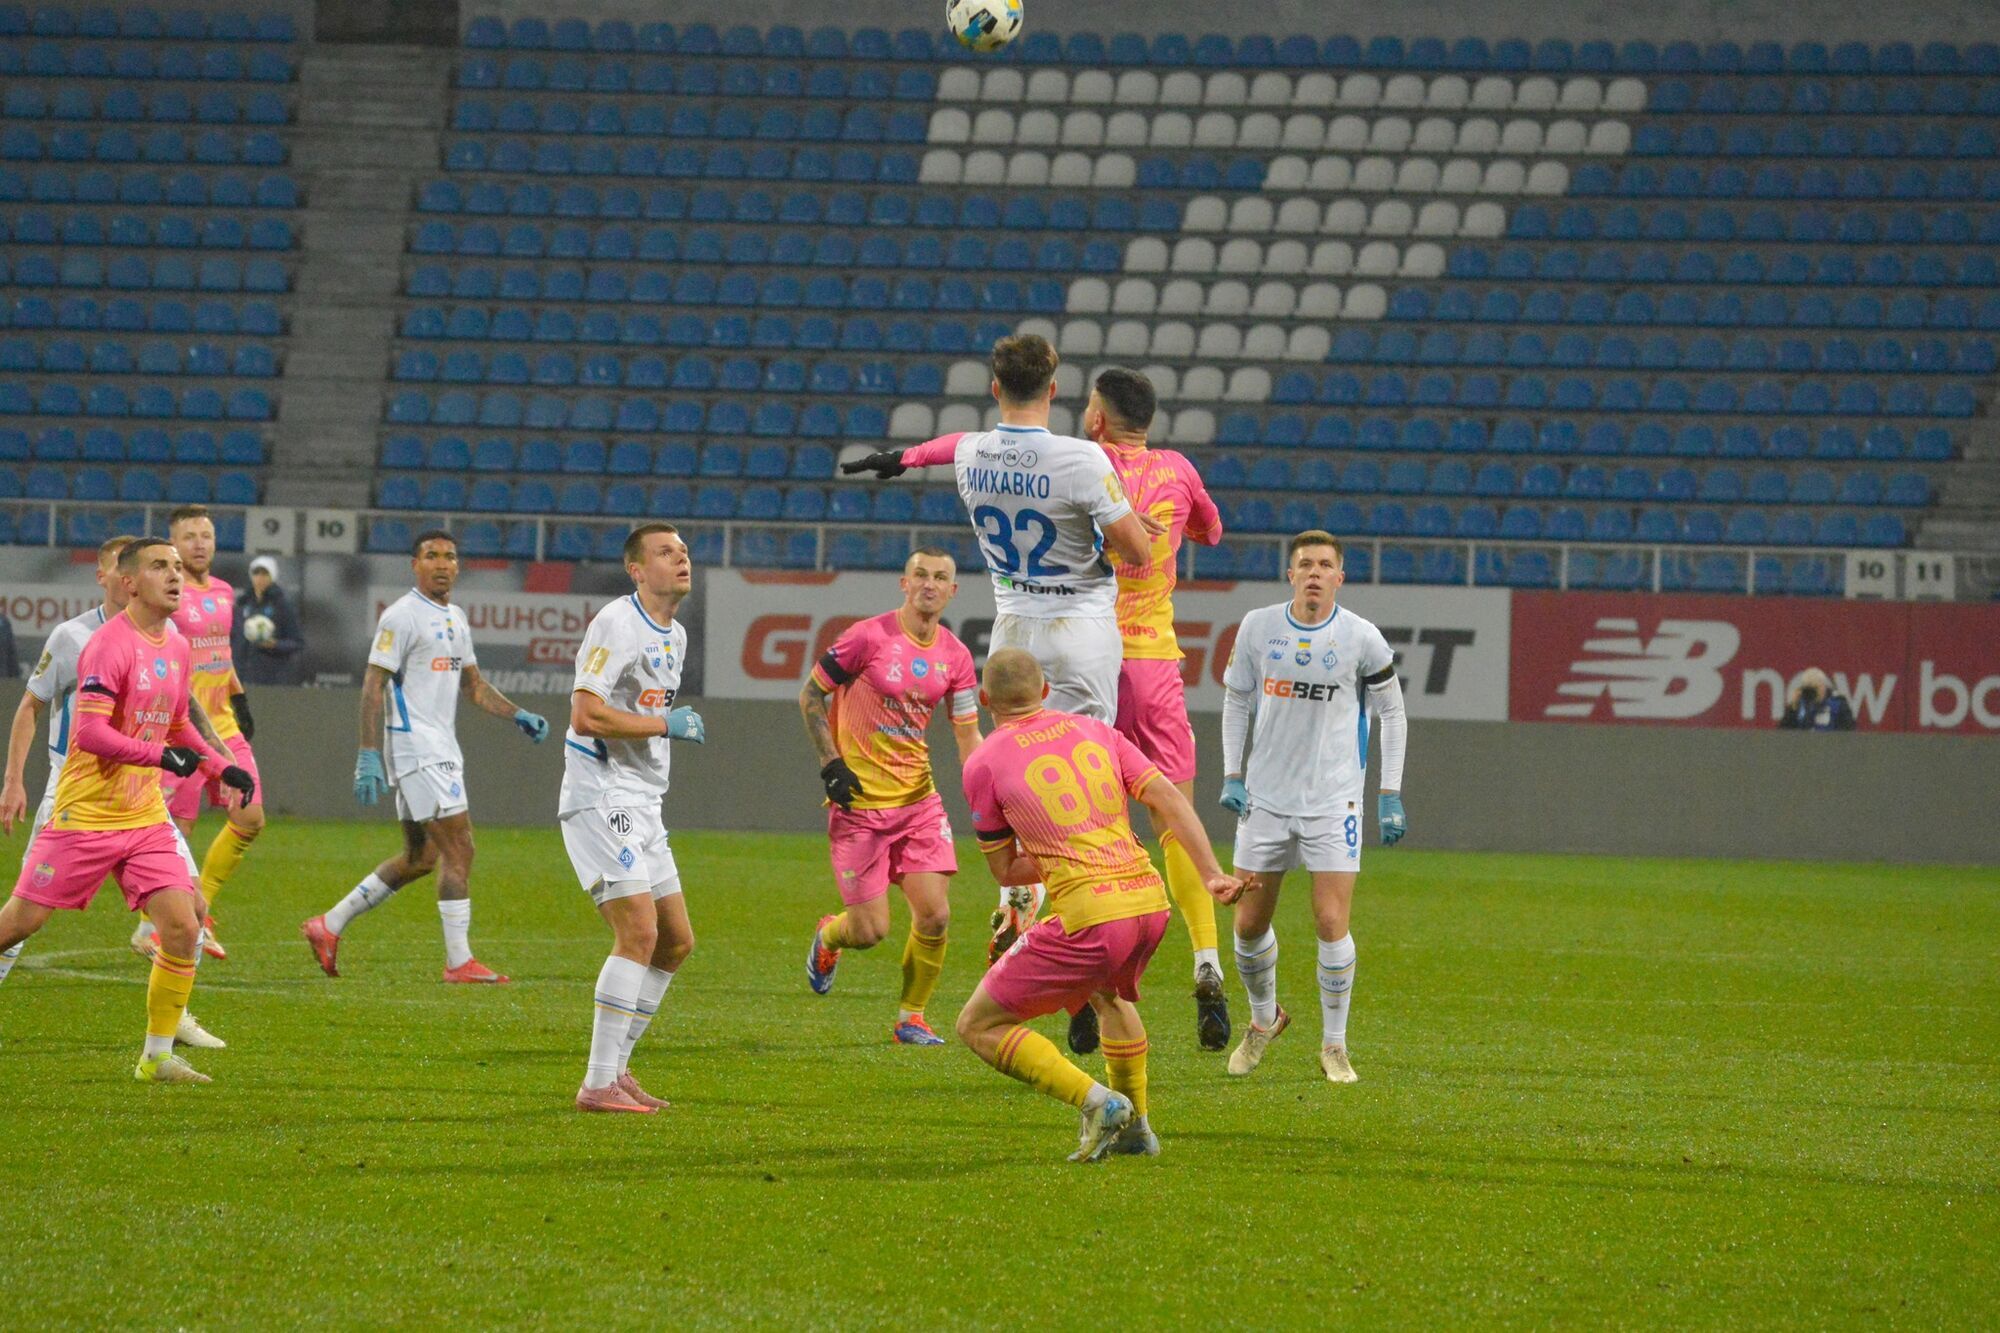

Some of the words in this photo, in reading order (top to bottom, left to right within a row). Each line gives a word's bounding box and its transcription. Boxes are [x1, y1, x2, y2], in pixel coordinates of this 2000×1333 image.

[976, 449, 1001, 461] Money
[967, 467, 1050, 499] МИХАВКО
[262, 517, 280, 537] 9
[317, 519, 345, 538] 10
[974, 505, 1070, 577] 32
[1858, 560, 1885, 580] 10
[1917, 562, 1942, 582] 11
[1024, 740, 1125, 827] 88
[610, 813, 631, 833] MG
[1343, 815, 1358, 848] 8
